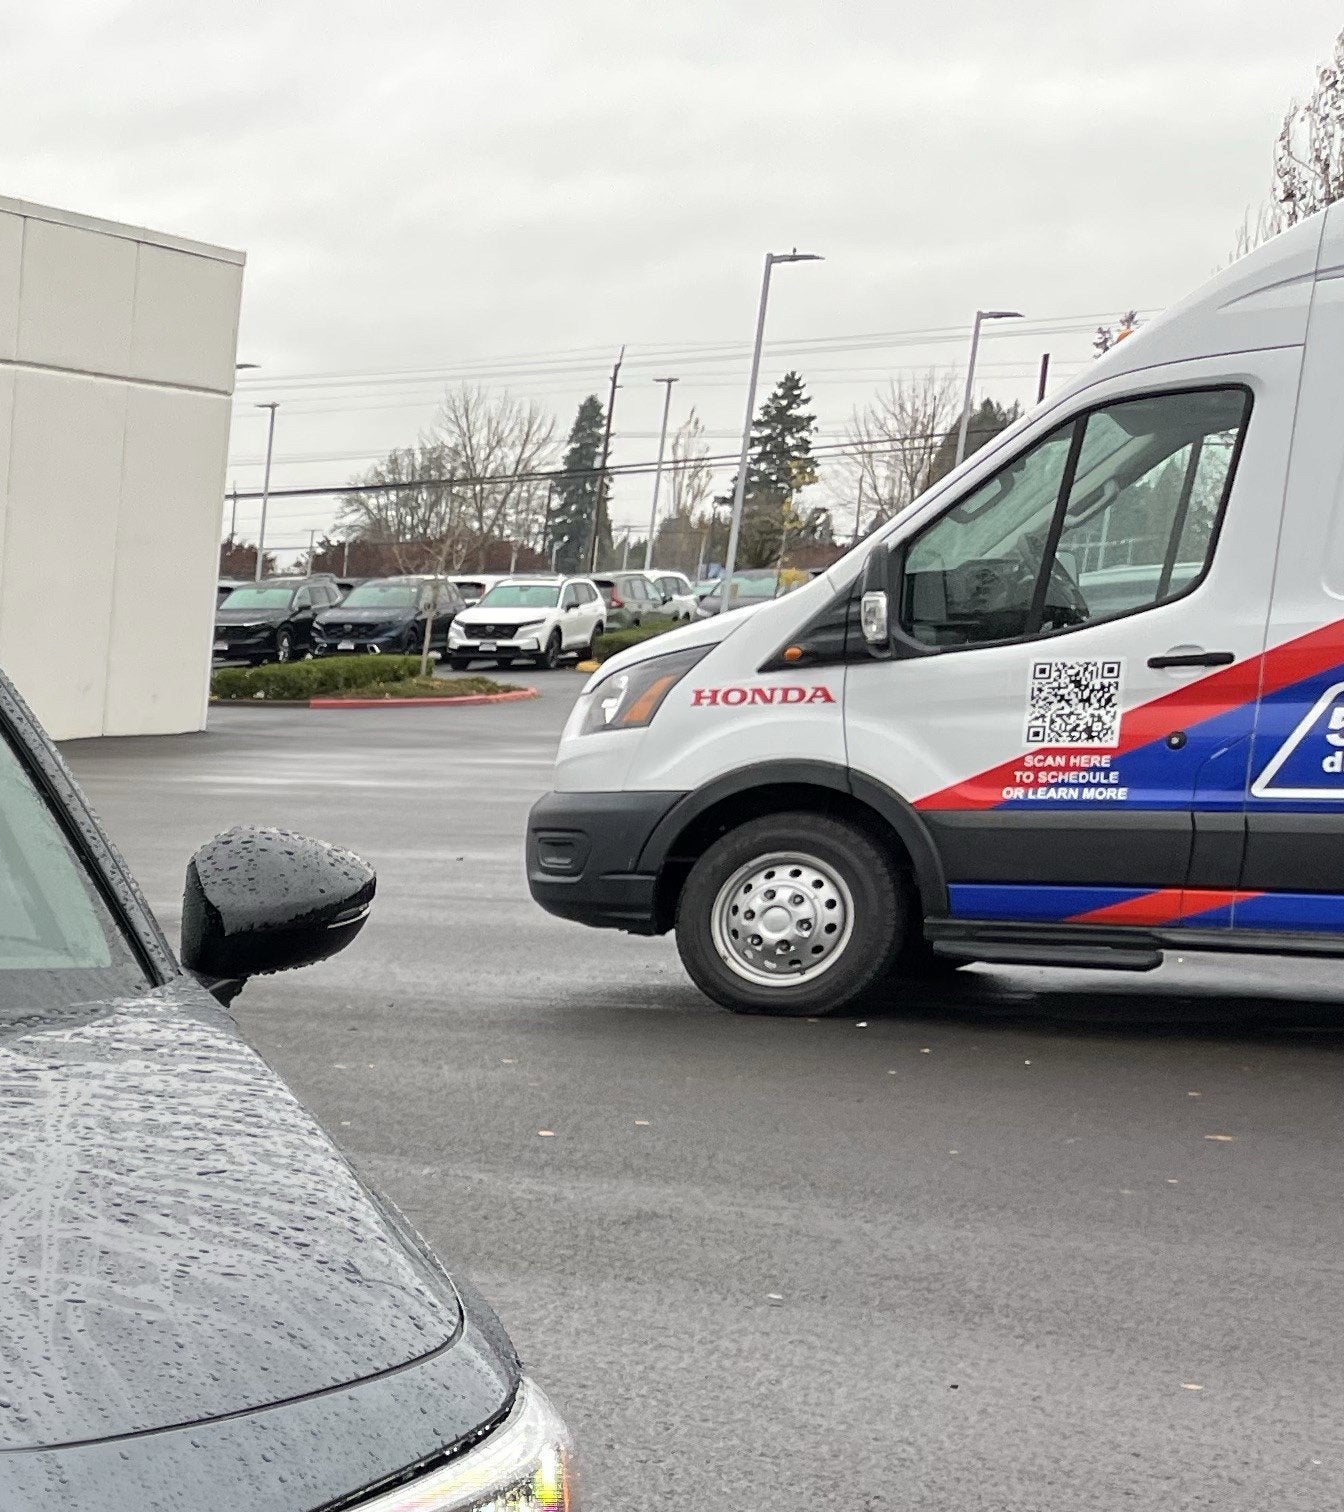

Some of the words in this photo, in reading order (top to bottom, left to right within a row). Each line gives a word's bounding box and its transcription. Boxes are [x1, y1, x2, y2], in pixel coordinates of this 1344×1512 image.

[690, 686, 837, 707] HONDA
[1023, 754, 1066, 768] SCAN
[1069, 754, 1112, 768] HERE
[1013, 770, 1035, 784] TO
[1037, 770, 1120, 784] SCHEDULE
[1001, 786, 1025, 800] OR
[1027, 786, 1079, 800] LEARN
[1081, 786, 1129, 800] MORE
